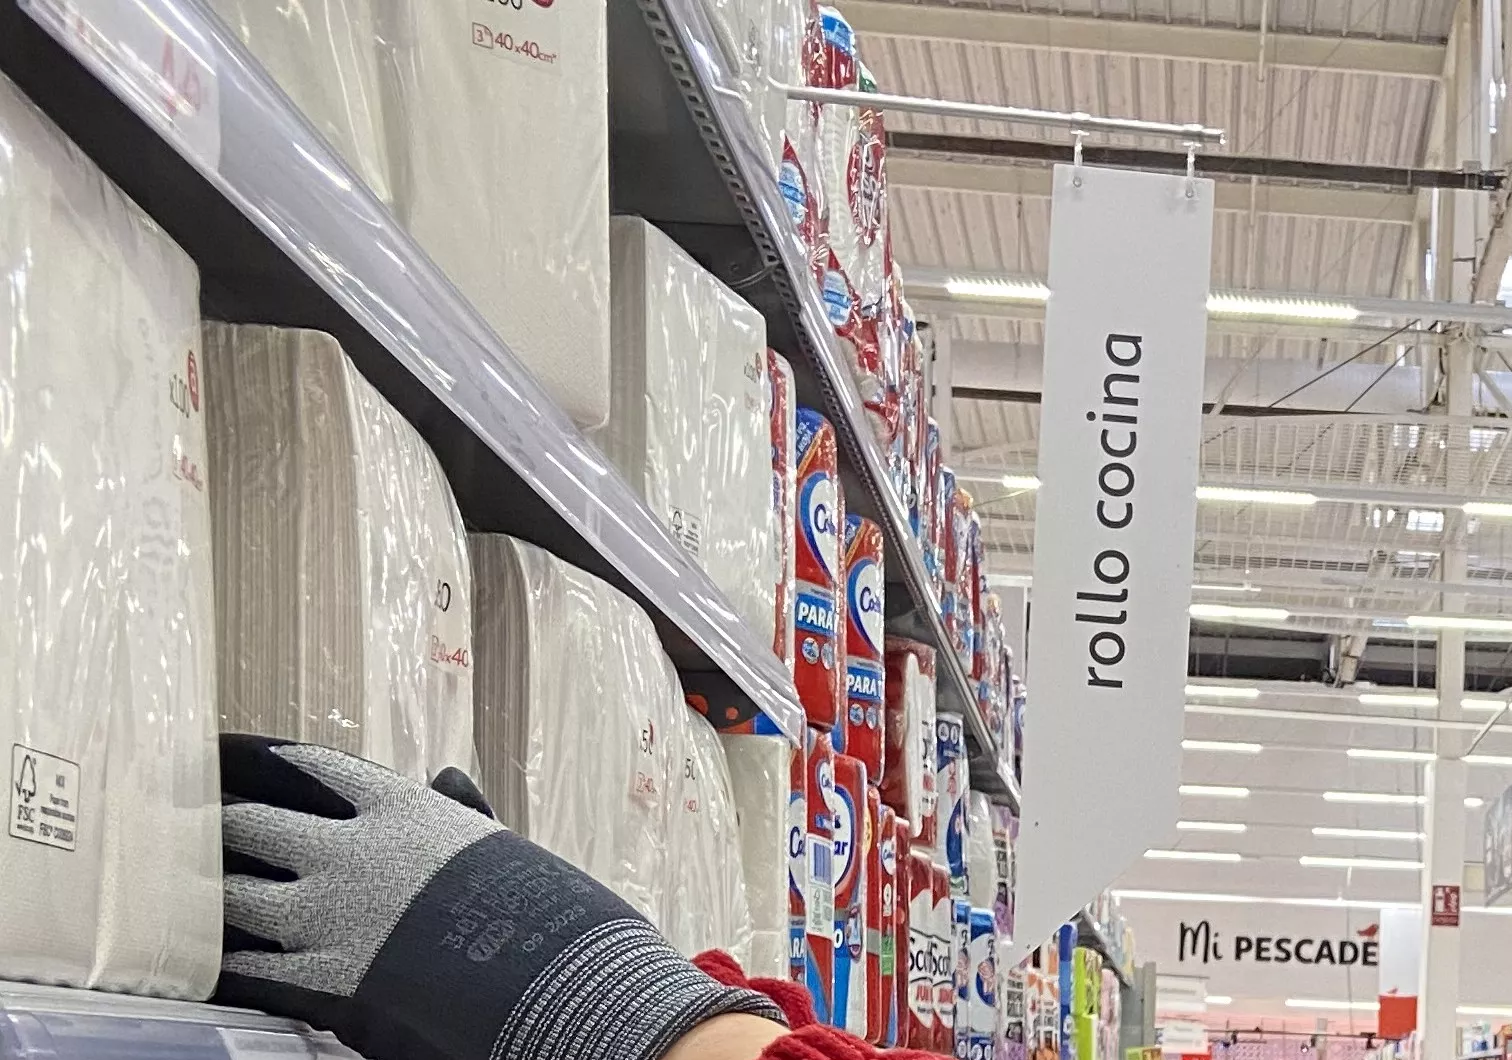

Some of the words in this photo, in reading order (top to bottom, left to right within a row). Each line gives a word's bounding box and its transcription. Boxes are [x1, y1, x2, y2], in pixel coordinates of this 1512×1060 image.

[1086, 332, 1143, 530] cocina
[1075, 549, 1131, 690] rollo
[1178, 919, 1224, 965] Mi
[1234, 935, 1380, 967] PESCADE
